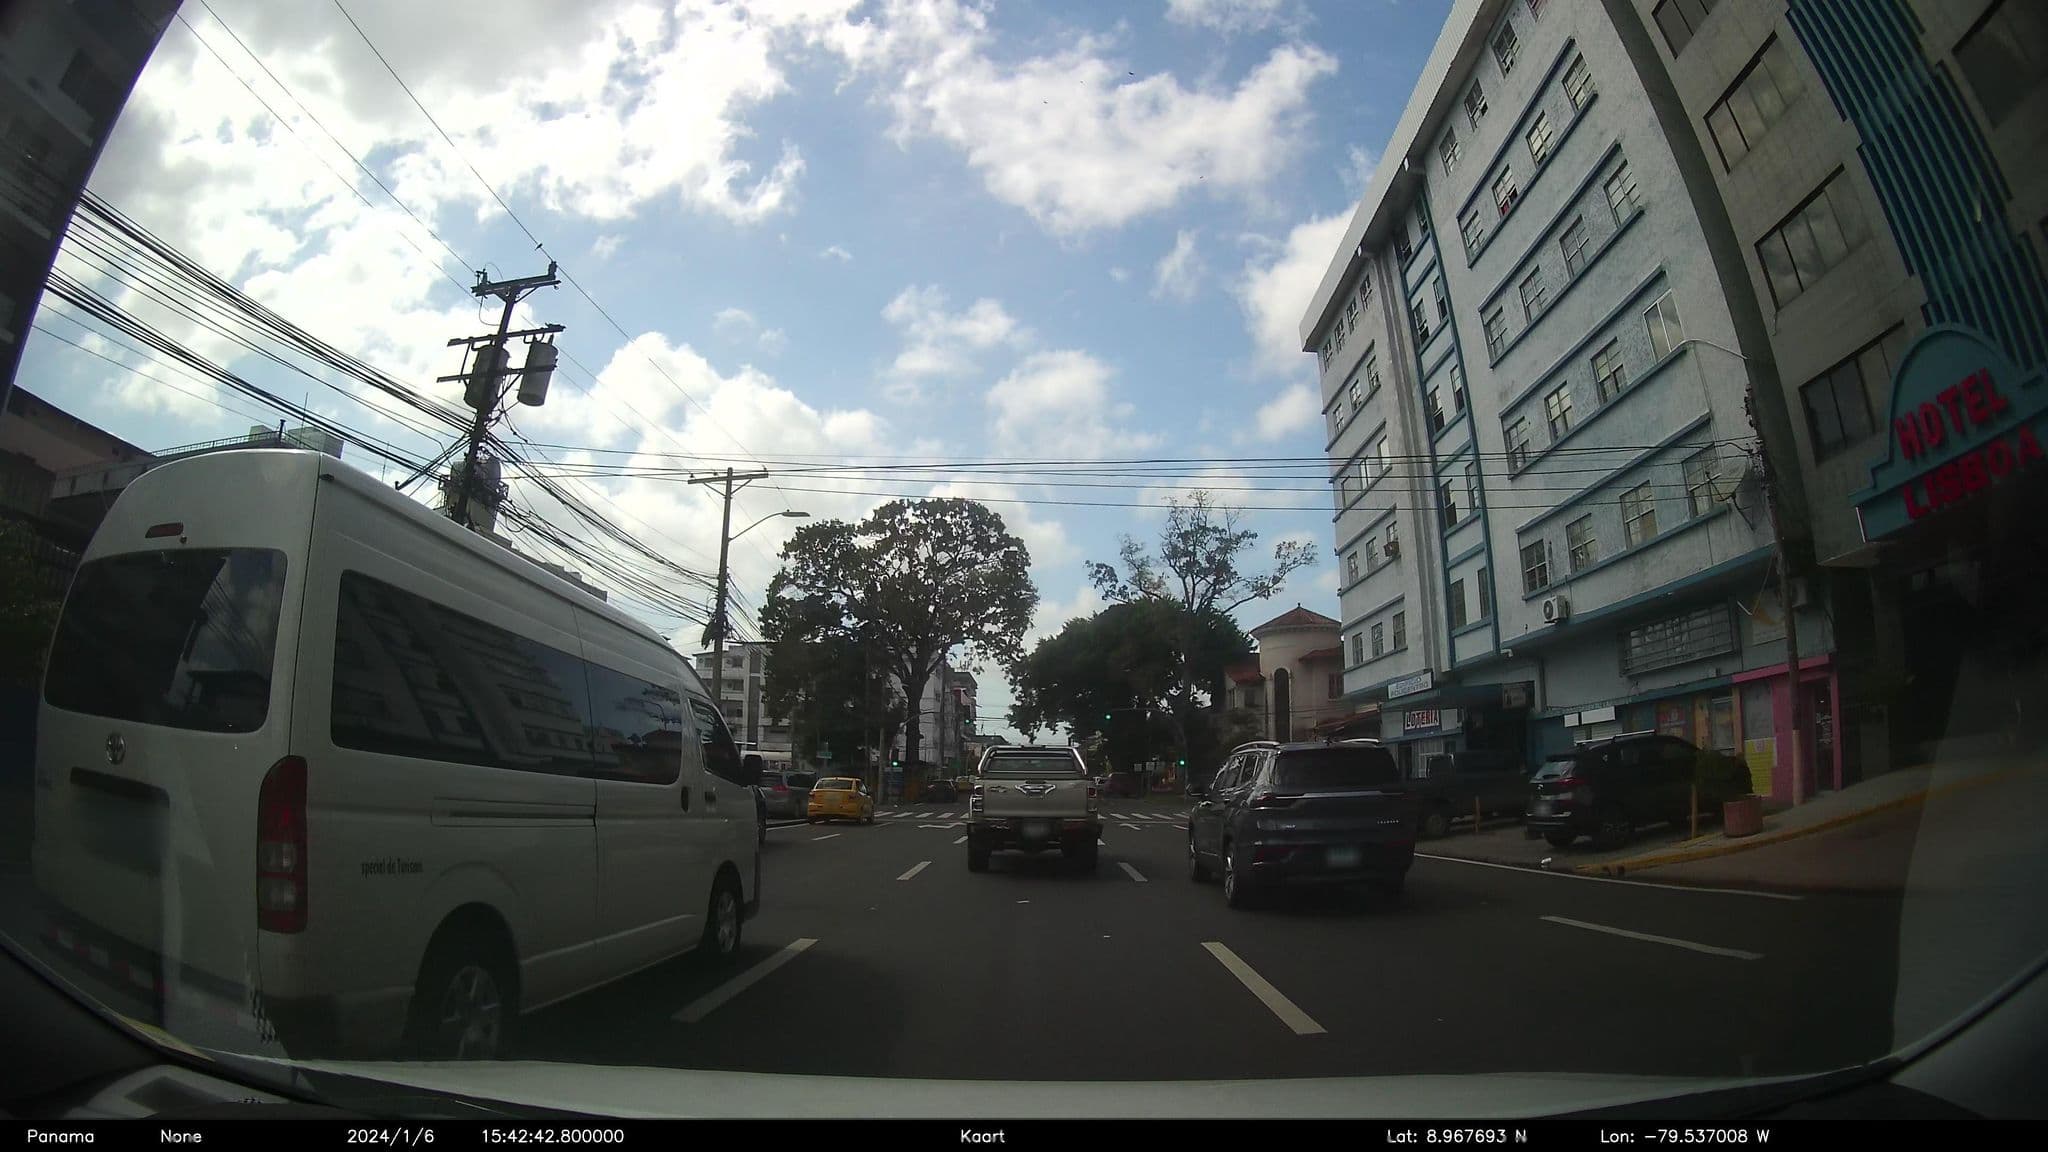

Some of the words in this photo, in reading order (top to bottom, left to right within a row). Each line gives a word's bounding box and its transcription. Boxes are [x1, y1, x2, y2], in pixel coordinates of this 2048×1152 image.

[1894, 367, 2008, 460] HOTEL
[1903, 424, 2045, 520] LISBOA
[1406, 709, 1439, 728] LOTERIA
